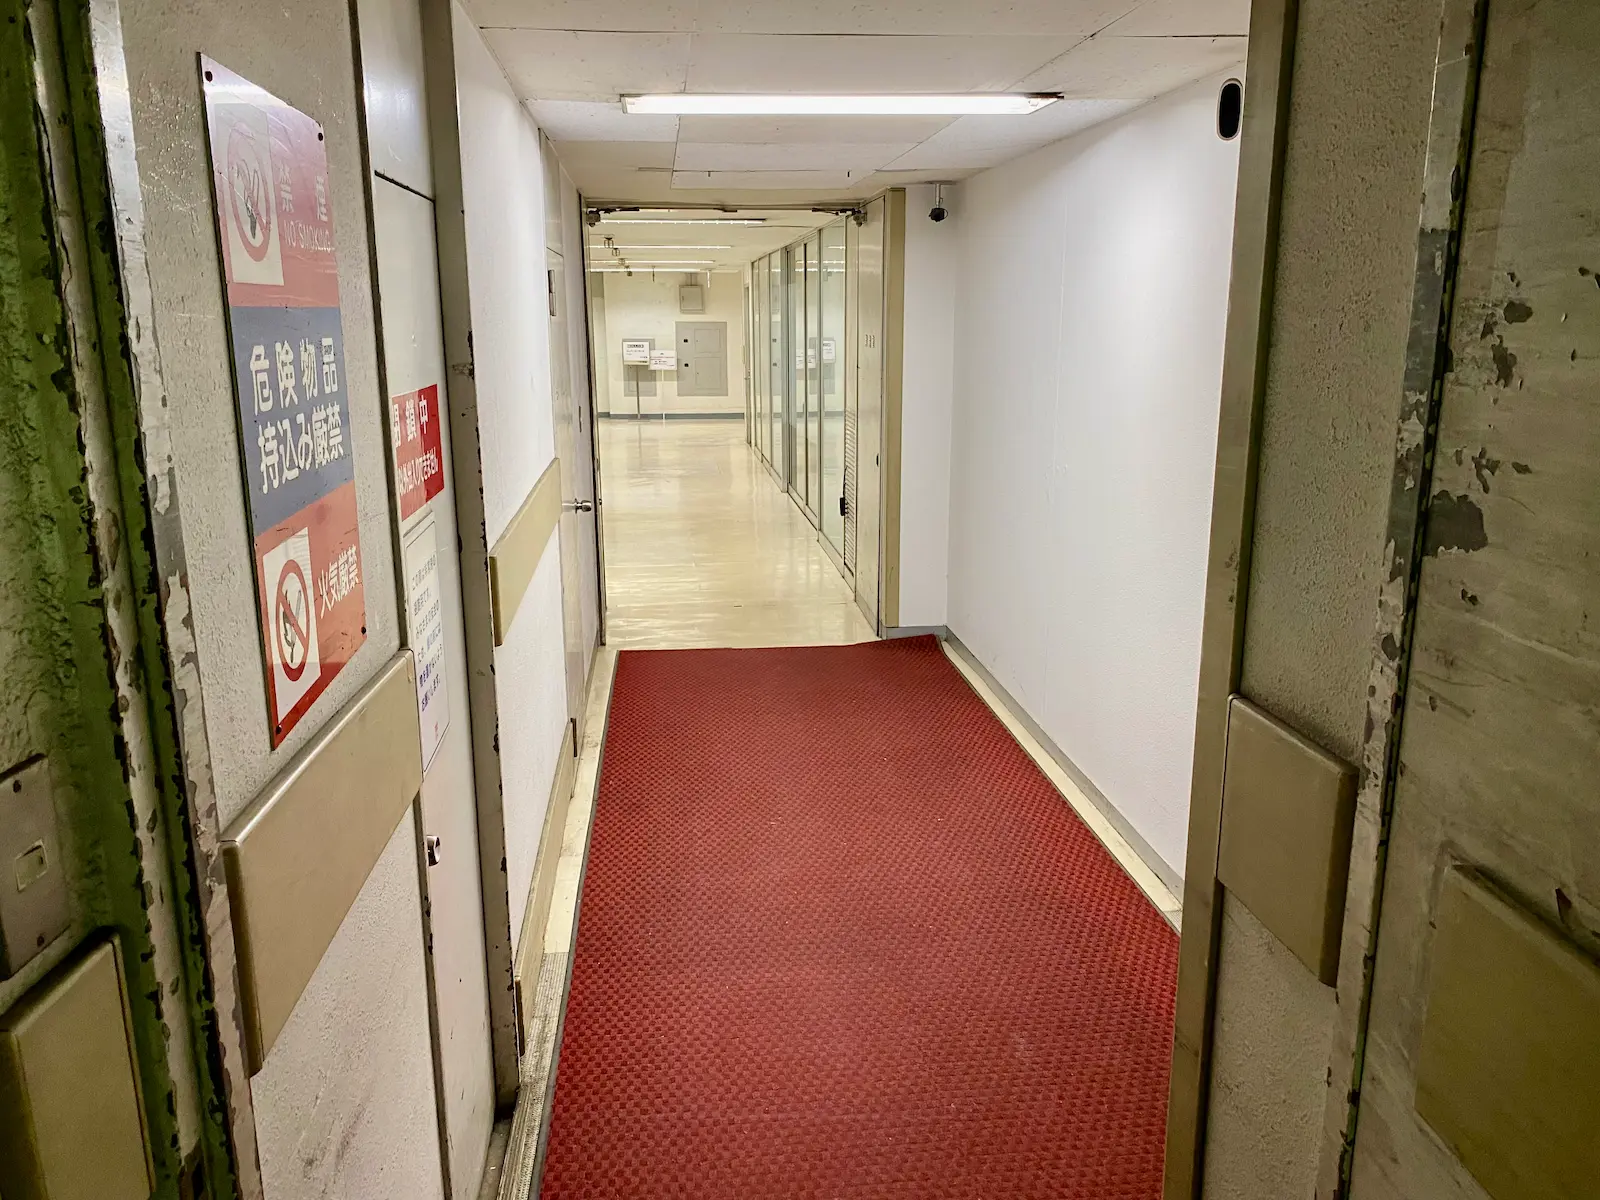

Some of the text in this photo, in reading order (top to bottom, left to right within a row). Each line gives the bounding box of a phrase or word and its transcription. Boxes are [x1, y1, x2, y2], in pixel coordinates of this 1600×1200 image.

[283, 219, 331, 254] NO SMOKING
[250, 337, 339, 416] 危険物品
[258, 401, 344, 494] 持込み厳禁
[318, 543, 359, 619] 火気厳禁
